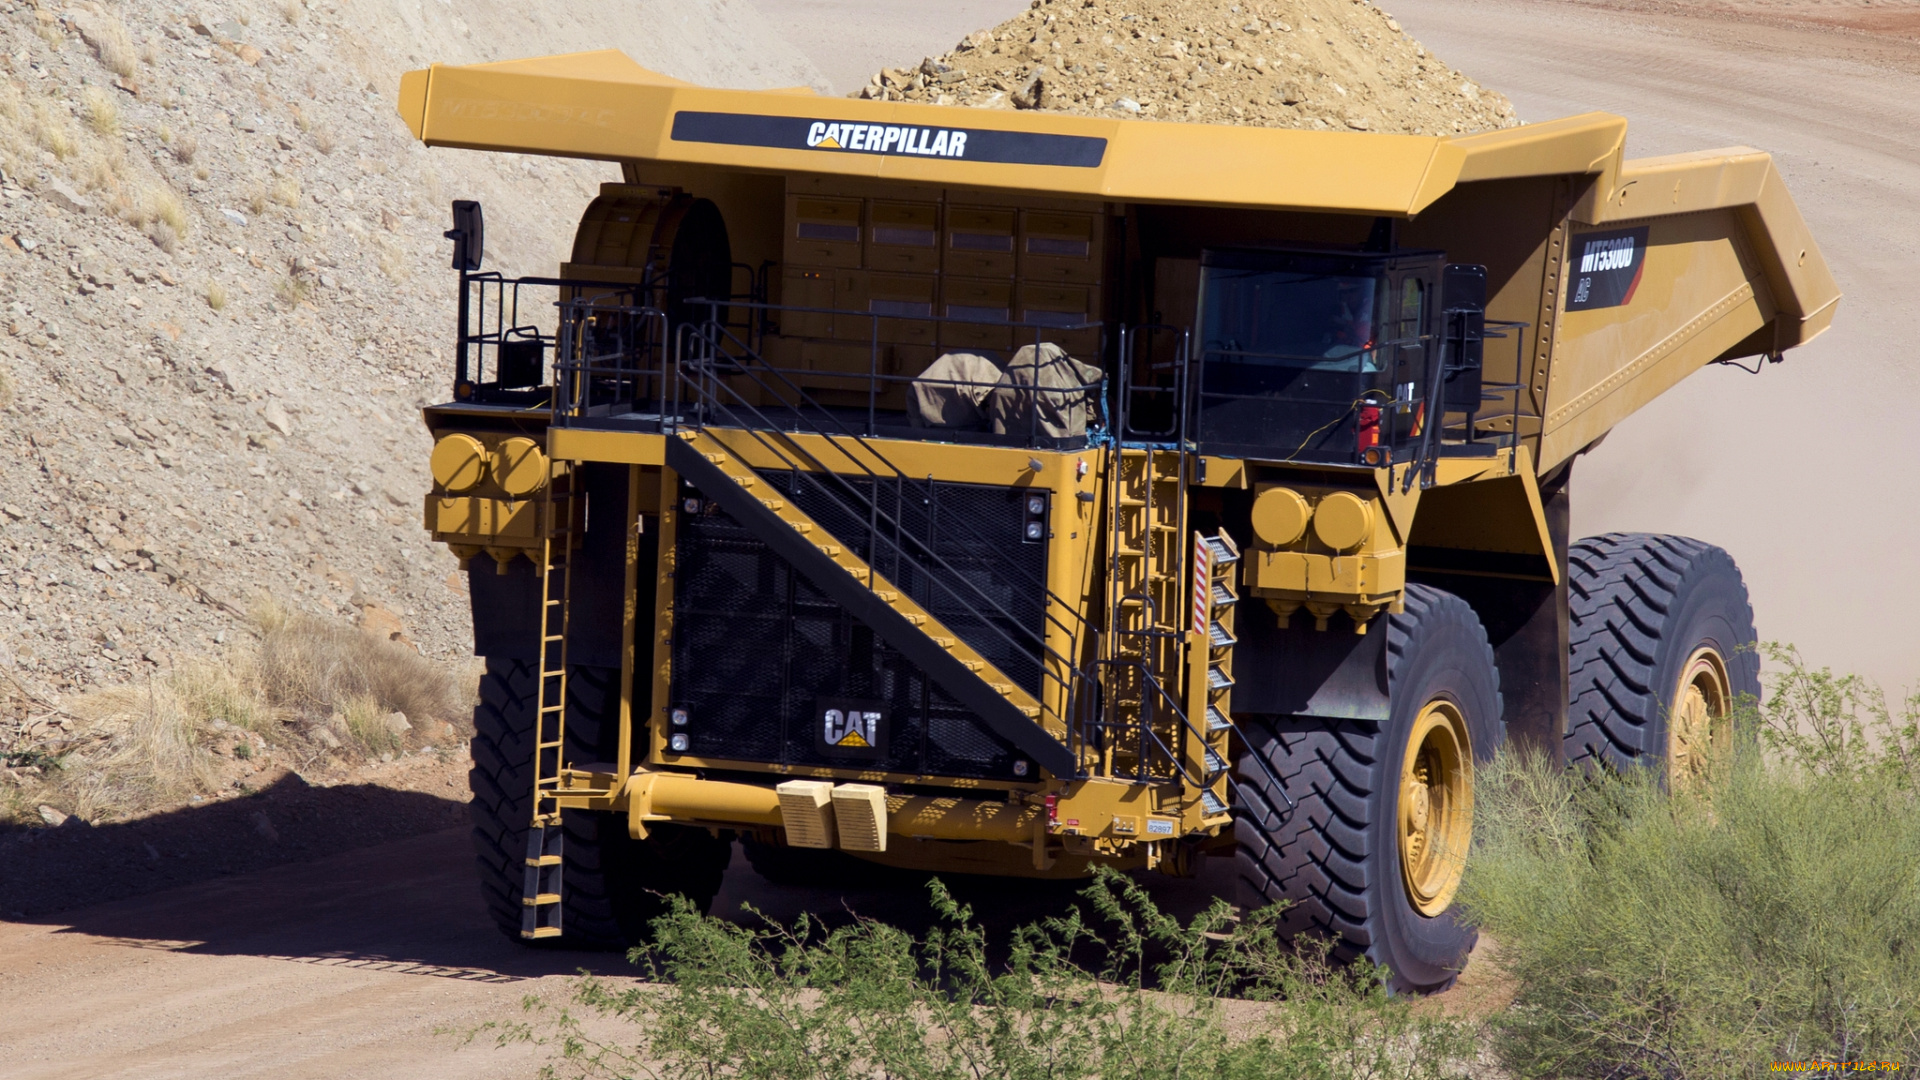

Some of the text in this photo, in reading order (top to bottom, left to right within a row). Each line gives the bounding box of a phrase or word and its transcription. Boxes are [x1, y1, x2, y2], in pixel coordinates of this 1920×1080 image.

[806, 122, 968, 157] CATERPILLAR
[1580, 236, 1635, 273] MT5300D
[1574, 277, 1592, 303] AC
[1395, 382, 1415, 414] CAT
[824, 709, 882, 747] CAT
